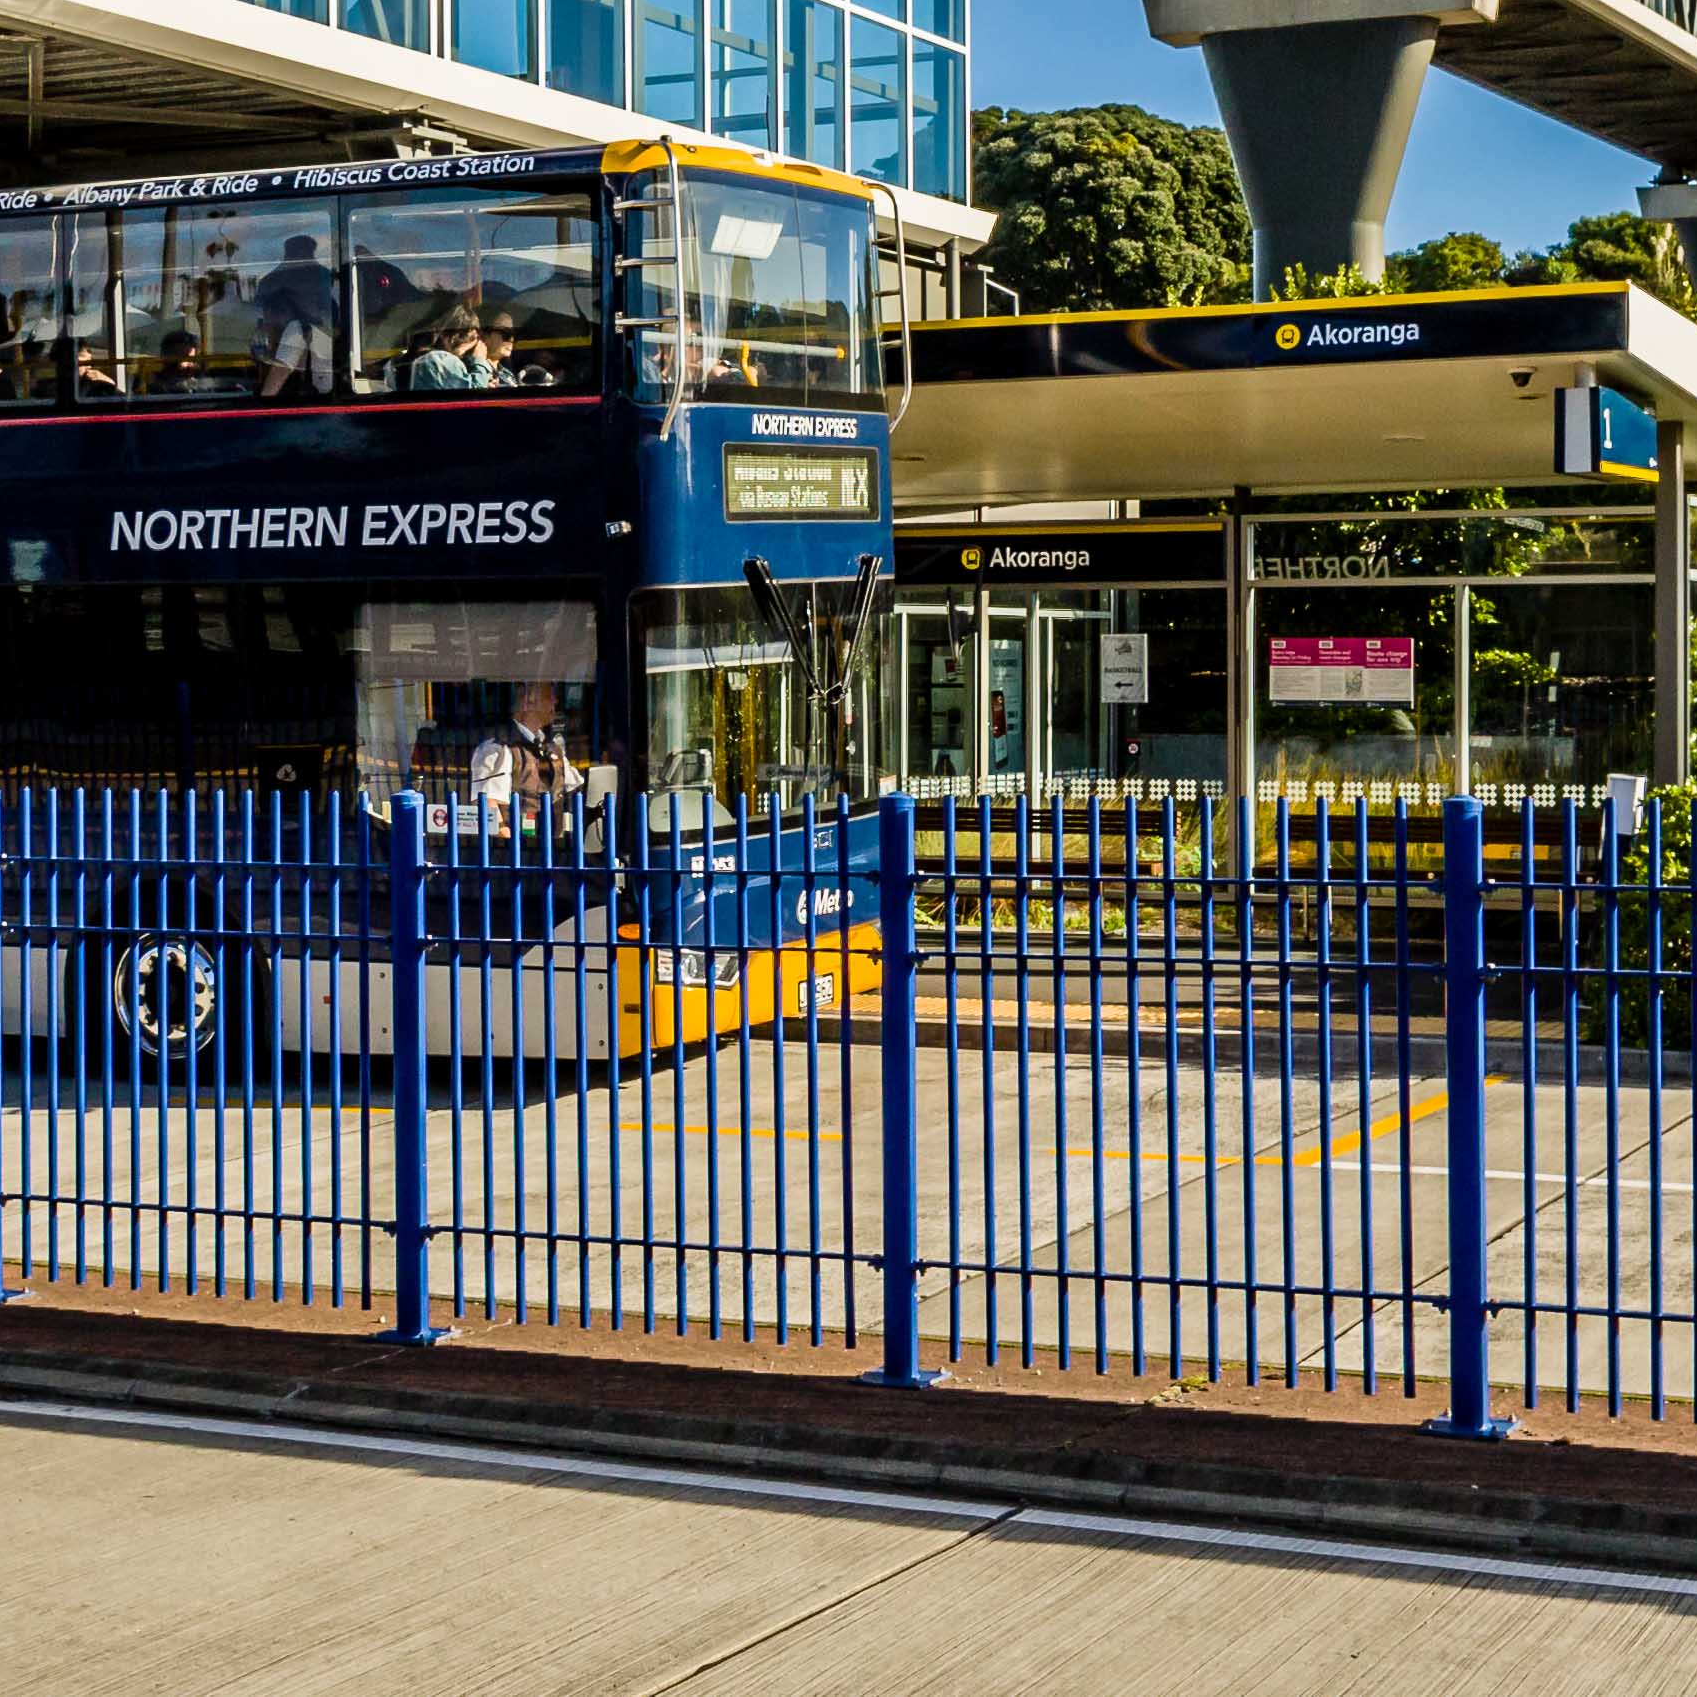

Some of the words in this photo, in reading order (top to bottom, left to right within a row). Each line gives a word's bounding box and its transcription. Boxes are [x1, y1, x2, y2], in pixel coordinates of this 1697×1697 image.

[63, 181, 138, 205] Albany
[139, 179, 183, 199] Park
[189, 180, 204, 197] &
[211, 174, 259, 195] Ride
[294, 165, 382, 189] Hibiscus
[387, 160, 451, 183] Coast
[455, 154, 535, 176] Station
[1306, 322, 1420, 347] Akoranga
[752, 414, 814, 436] NORTHERN
[815, 417, 857, 439] EXPRESS
[1603, 408, 1613, 449] 1
[110, 506, 349, 551] NORTHERN
[361, 500, 556, 547] EXPRESS
[989, 546, 1090, 570] Akoranga
[814, 887, 854, 916] Meto
